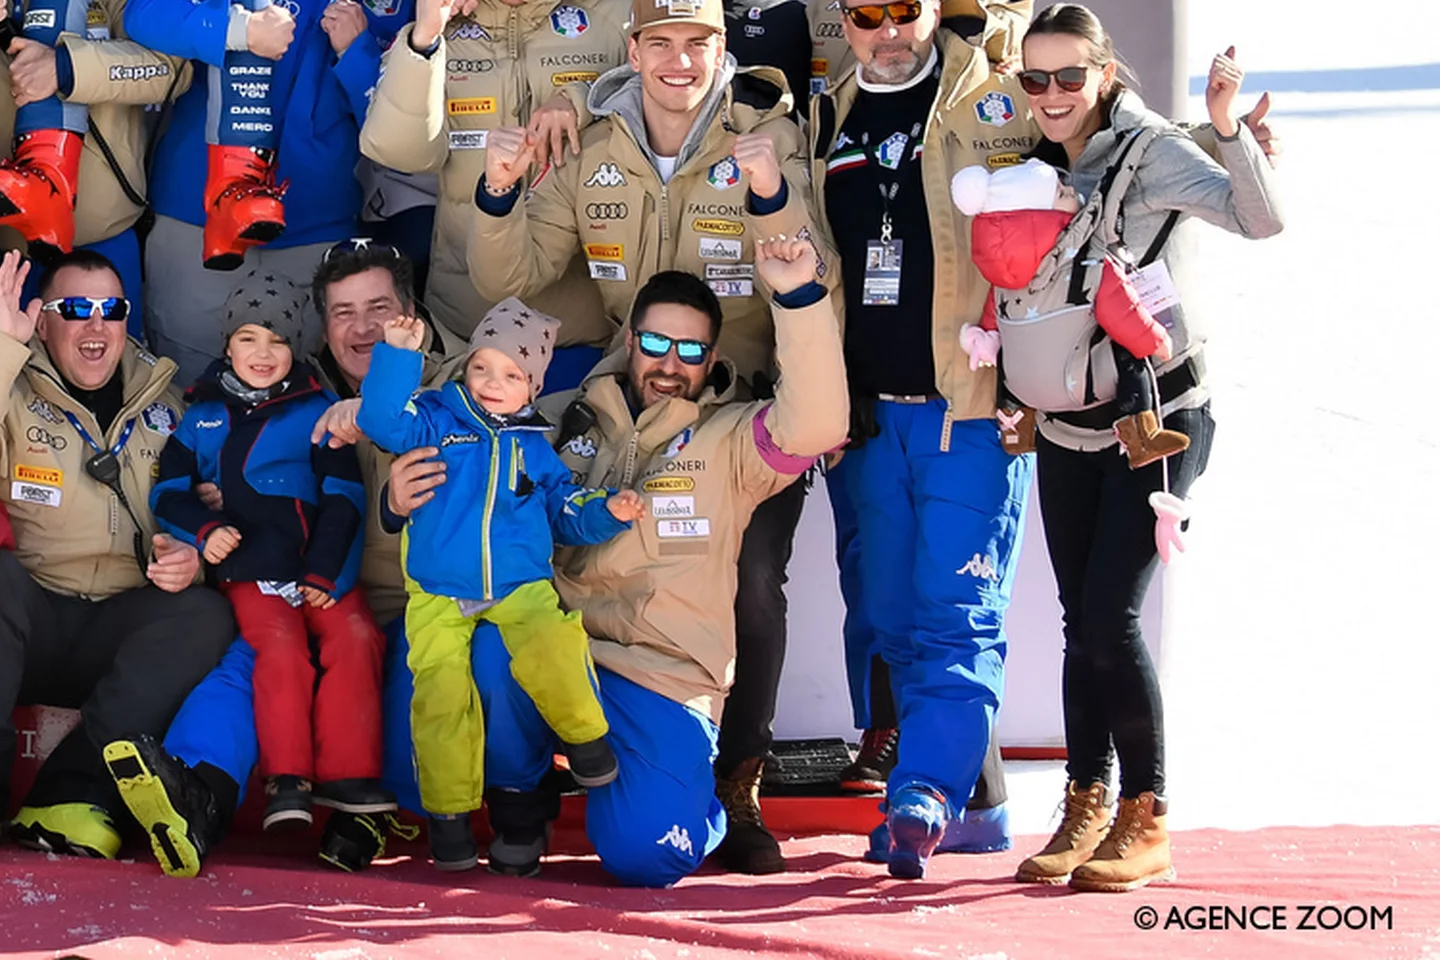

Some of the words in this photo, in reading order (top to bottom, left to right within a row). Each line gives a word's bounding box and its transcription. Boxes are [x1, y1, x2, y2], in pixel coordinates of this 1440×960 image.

[540, 53, 609, 67] FALCONERI
[108, 62, 170, 82] Kappa
[450, 100, 492, 113] PIRELLI
[687, 202, 745, 218] FALCONE
[26, 444, 49, 454] Audi
[17, 466, 59, 482] PIRELLI
